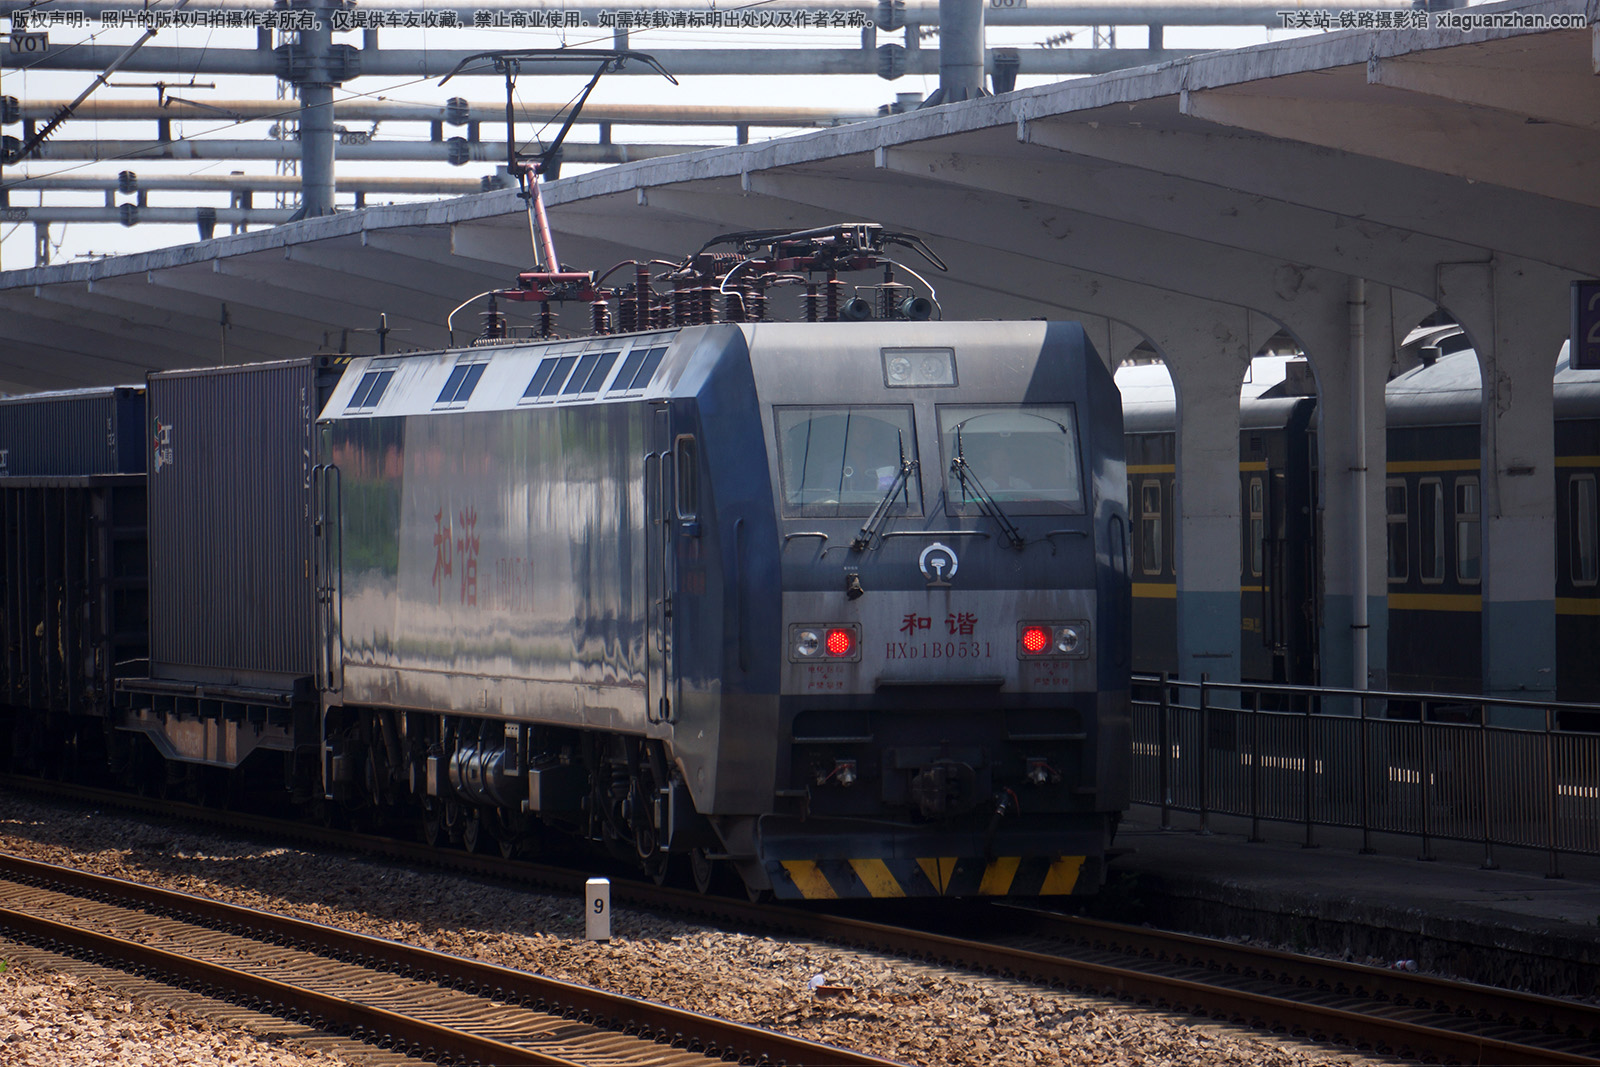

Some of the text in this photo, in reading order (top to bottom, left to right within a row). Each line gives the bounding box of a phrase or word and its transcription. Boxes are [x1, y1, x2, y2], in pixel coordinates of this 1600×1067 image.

[13, 36, 46, 52] Y01
[341, 134, 366, 145] 063
[432, 505, 480, 608] 和谐
[900, 612, 978, 636] 和谐
[593, 898, 604, 914] 9
